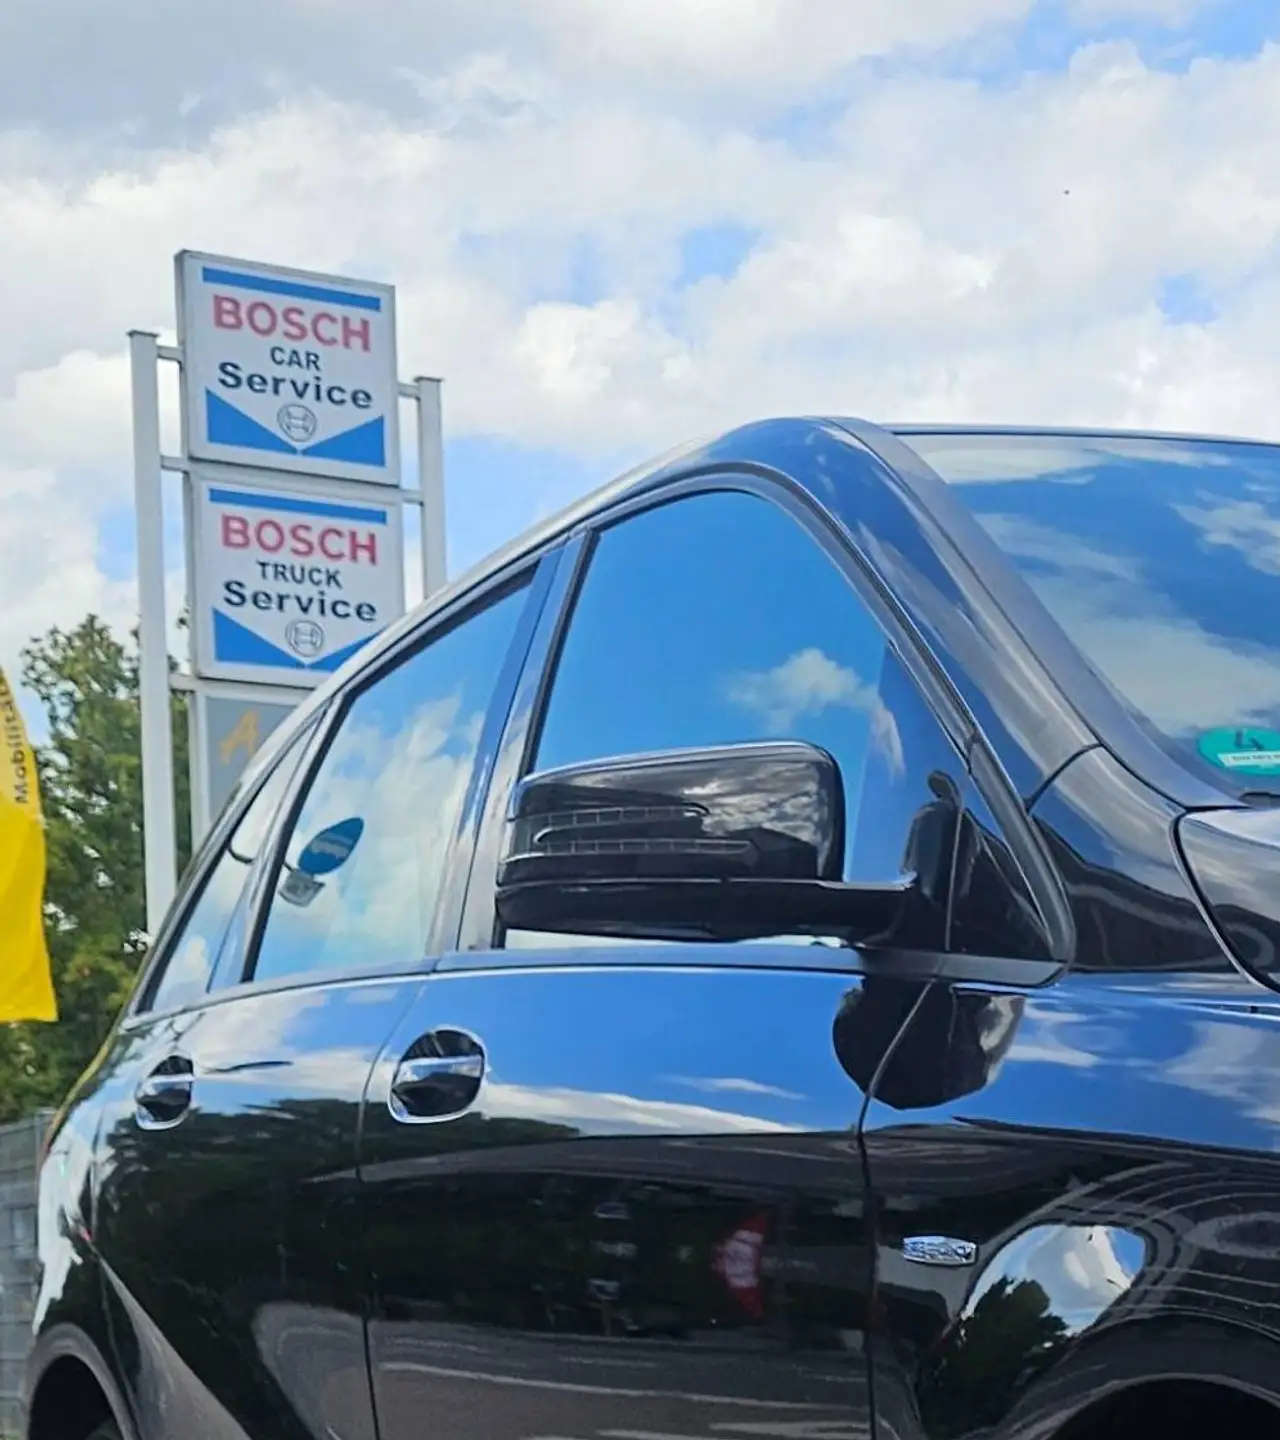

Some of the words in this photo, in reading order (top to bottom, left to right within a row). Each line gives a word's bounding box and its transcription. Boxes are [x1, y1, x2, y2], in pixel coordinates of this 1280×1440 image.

[213, 294, 371, 353] BOSCH
[270, 346, 322, 371] CAR
[218, 361, 373, 409] Service
[221, 513, 377, 566] BOSCH
[256, 560, 343, 589] TRUCK
[223, 580, 377, 622] Service
